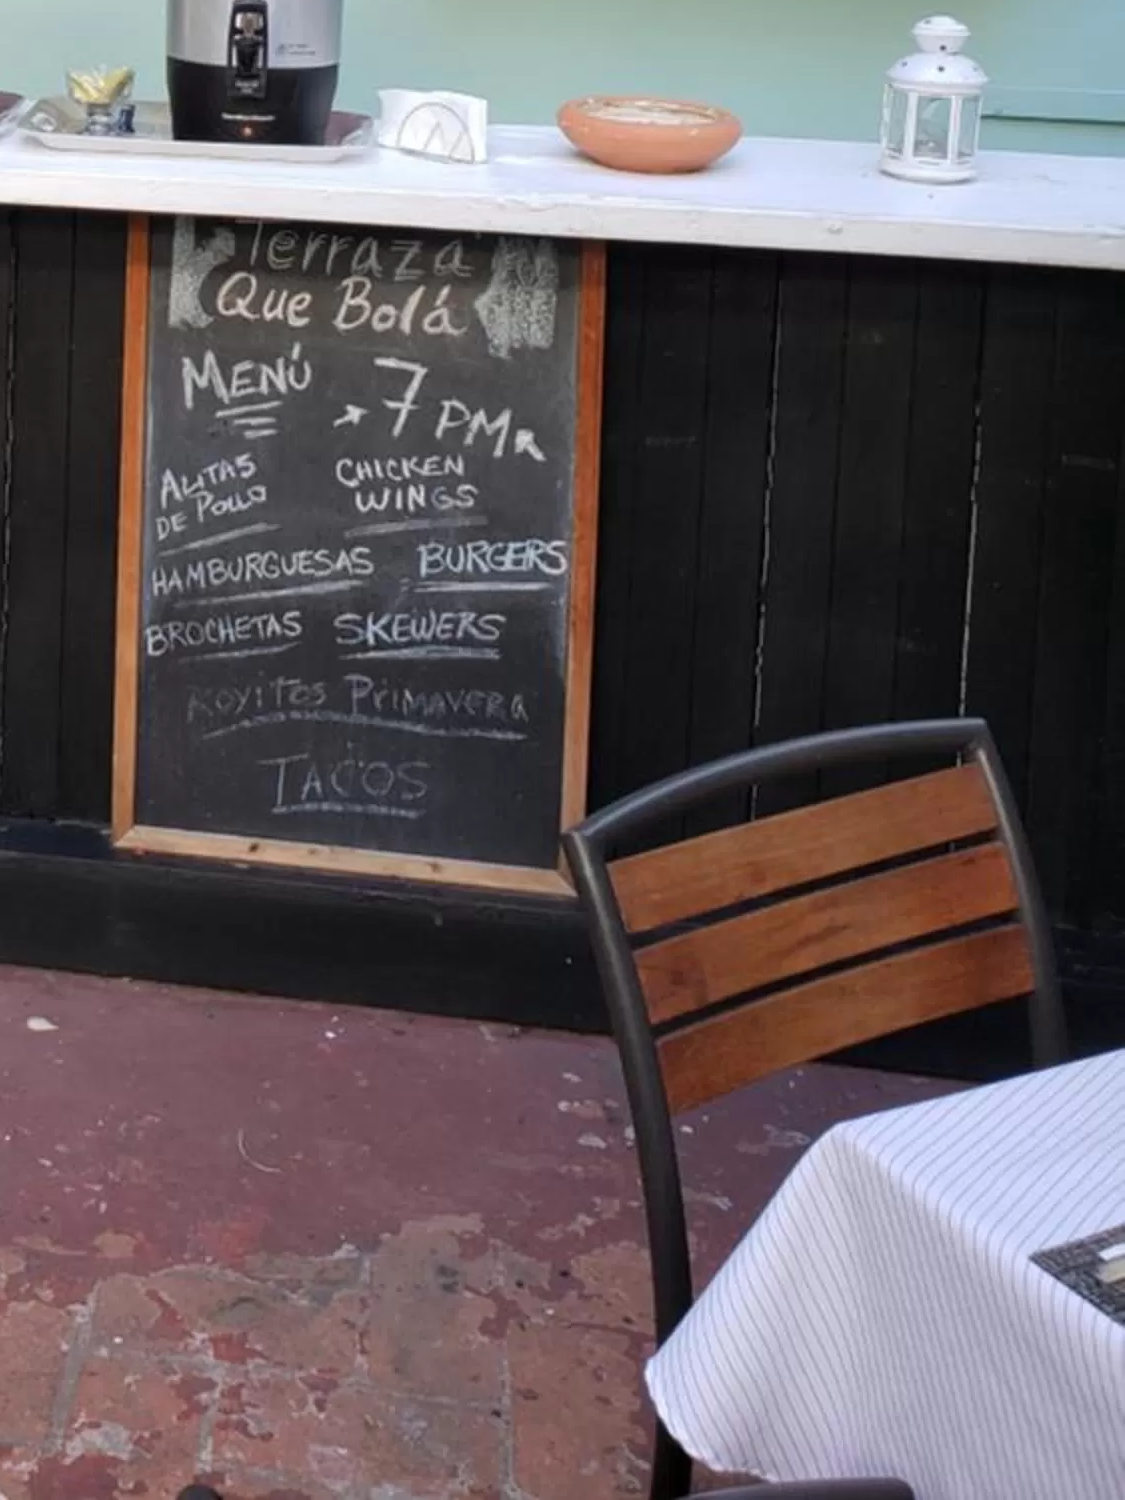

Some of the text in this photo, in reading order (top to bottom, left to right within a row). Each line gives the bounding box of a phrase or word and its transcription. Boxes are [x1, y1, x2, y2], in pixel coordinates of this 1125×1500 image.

[216, 272, 469, 336] Que Bolá
[181, 342, 312, 410] MENÚ
[374, 357, 512, 459] 7 PM
[160, 452, 257, 508] ALITAS
[335, 454, 465, 488] CHICKEN
[354, 484, 479, 513] WINGS
[156, 485, 268, 541] DE POLLO
[151, 547, 375, 597] HAMBURGUESAS
[416, 539, 567, 577] BURGERS
[145, 611, 507, 657] BROCHETAS SKEWERS
[257, 754, 428, 810] TACOS
